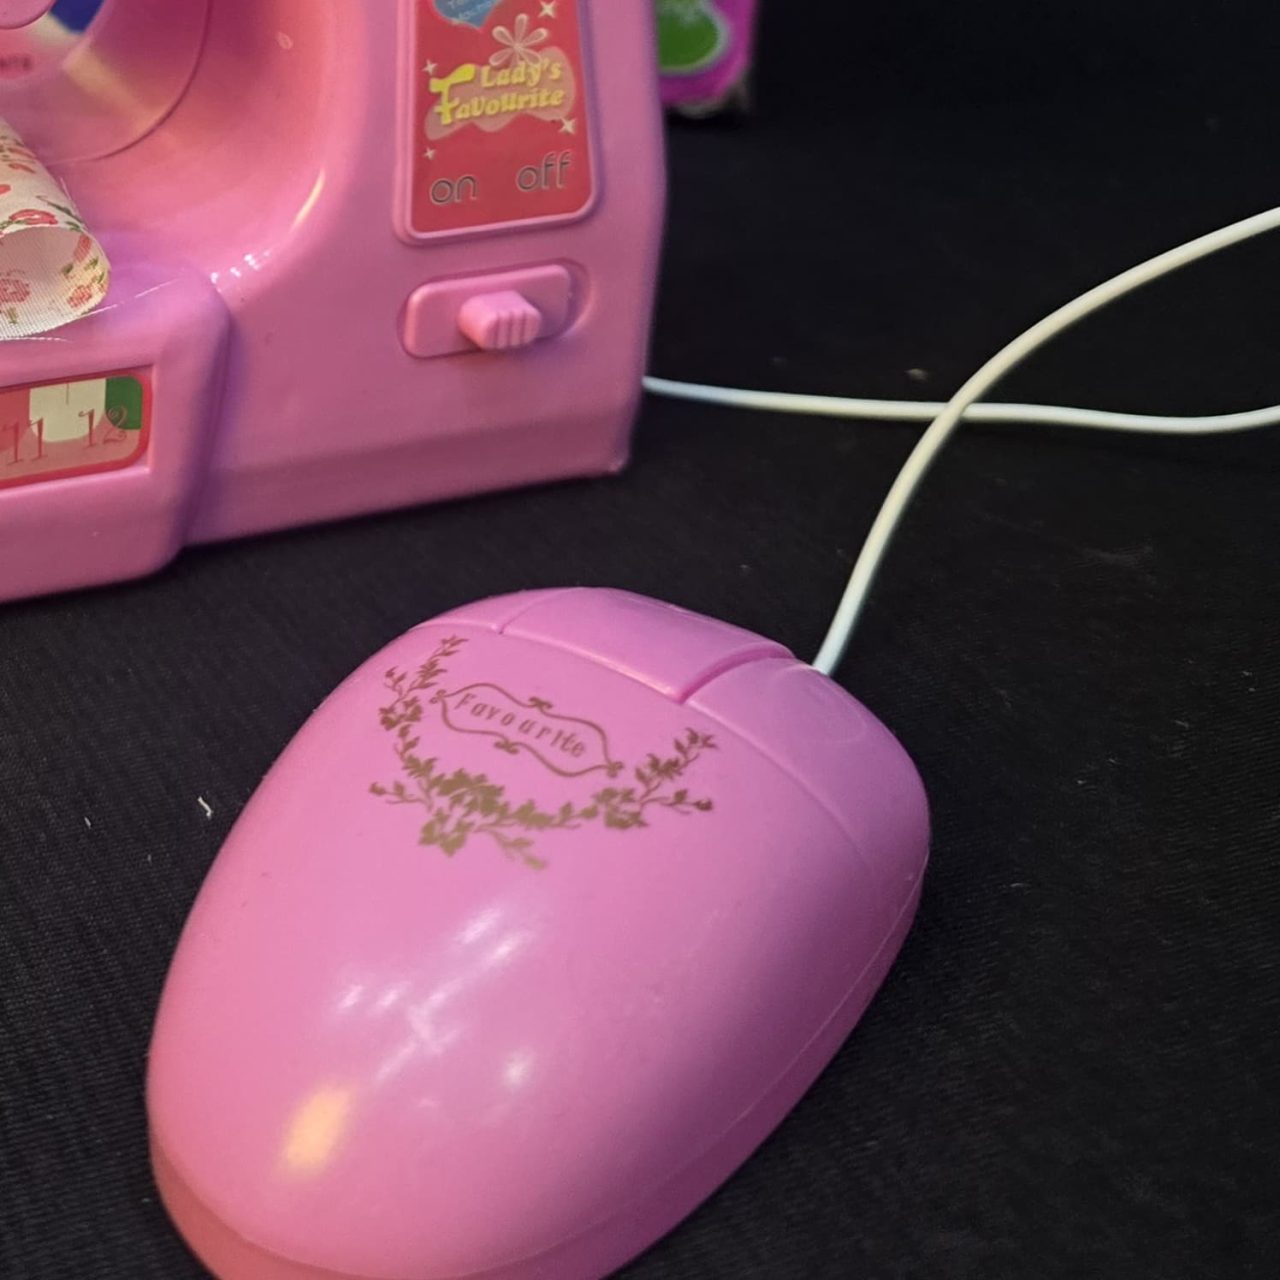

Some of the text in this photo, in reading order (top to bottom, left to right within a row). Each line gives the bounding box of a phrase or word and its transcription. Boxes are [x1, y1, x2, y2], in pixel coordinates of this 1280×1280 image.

[429, 63, 567, 126] Favourite
[481, 60, 563, 89] Lady's
[431, 149, 575, 206] on off
[2, 416, 50, 466] 11
[77, 404, 129, 450] 12
